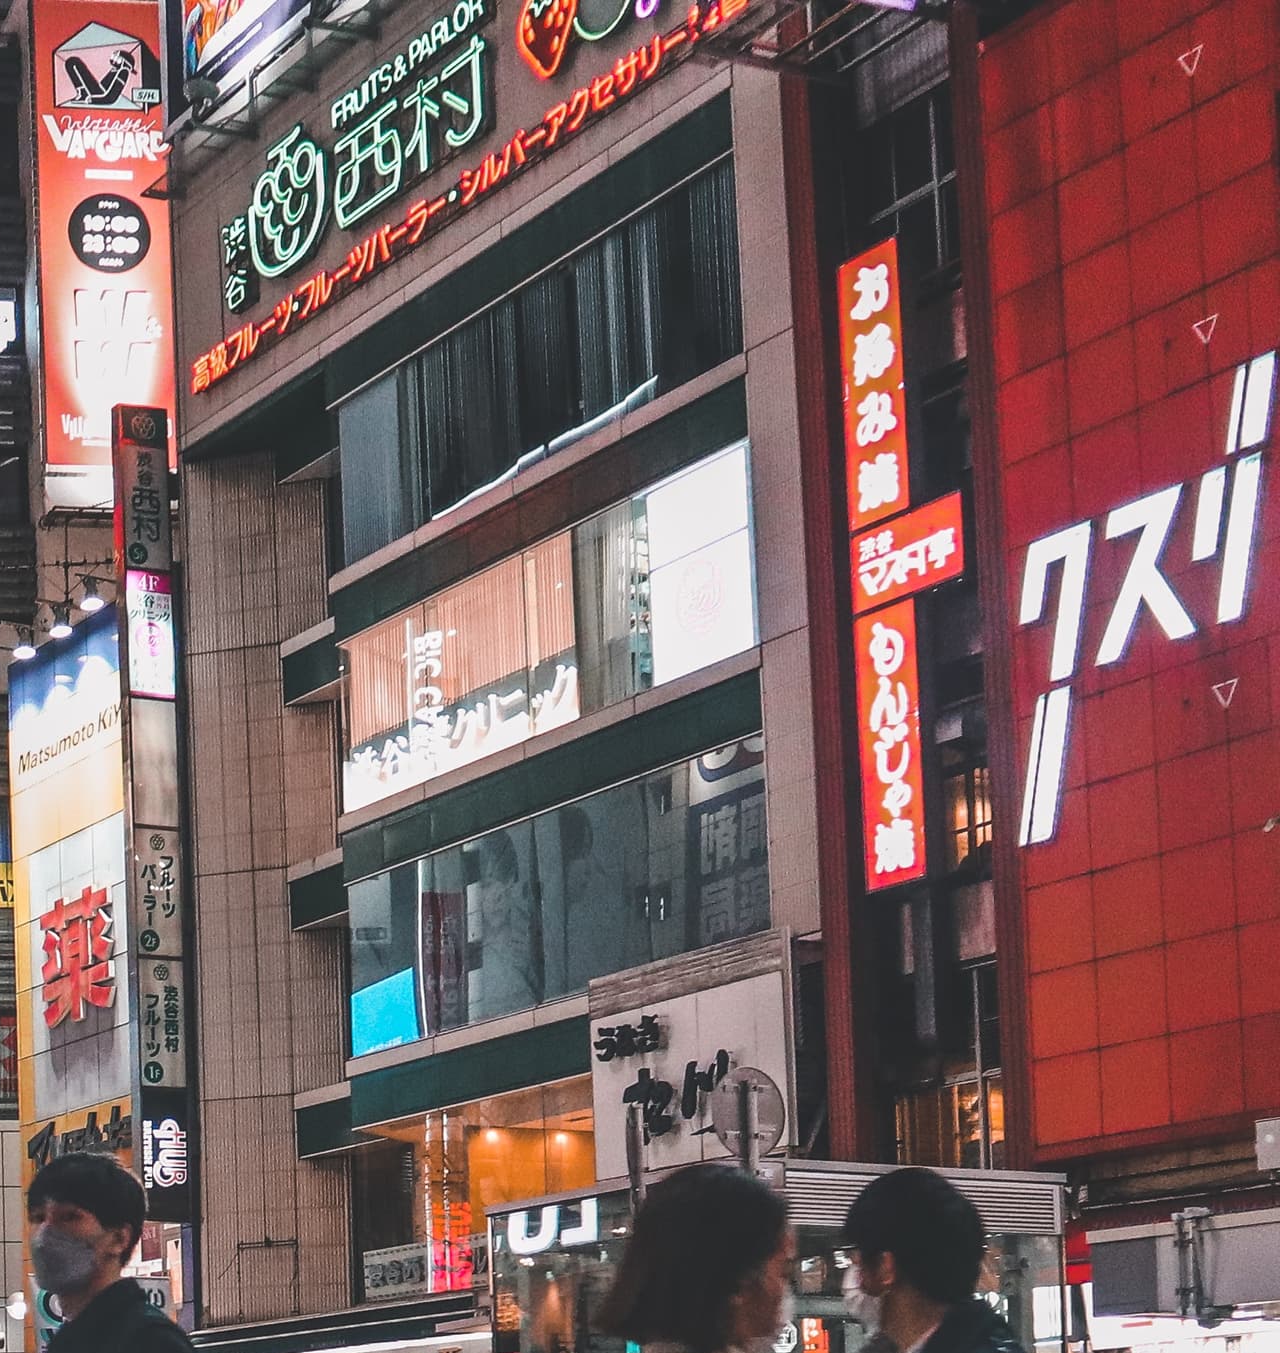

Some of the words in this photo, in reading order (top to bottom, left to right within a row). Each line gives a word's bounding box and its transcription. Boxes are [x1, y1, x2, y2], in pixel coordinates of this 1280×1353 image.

[42, 114, 170, 162] VANGUARD
[334, 35, 485, 229] 西村
[221, 217, 247, 312] 渋谷
[18, 719, 95, 775] Matsumoto
[40, 886, 116, 1029] 薬
[145, 993, 161, 1058] フルーツ
[163, 985, 180, 1054] 渋谷西村
